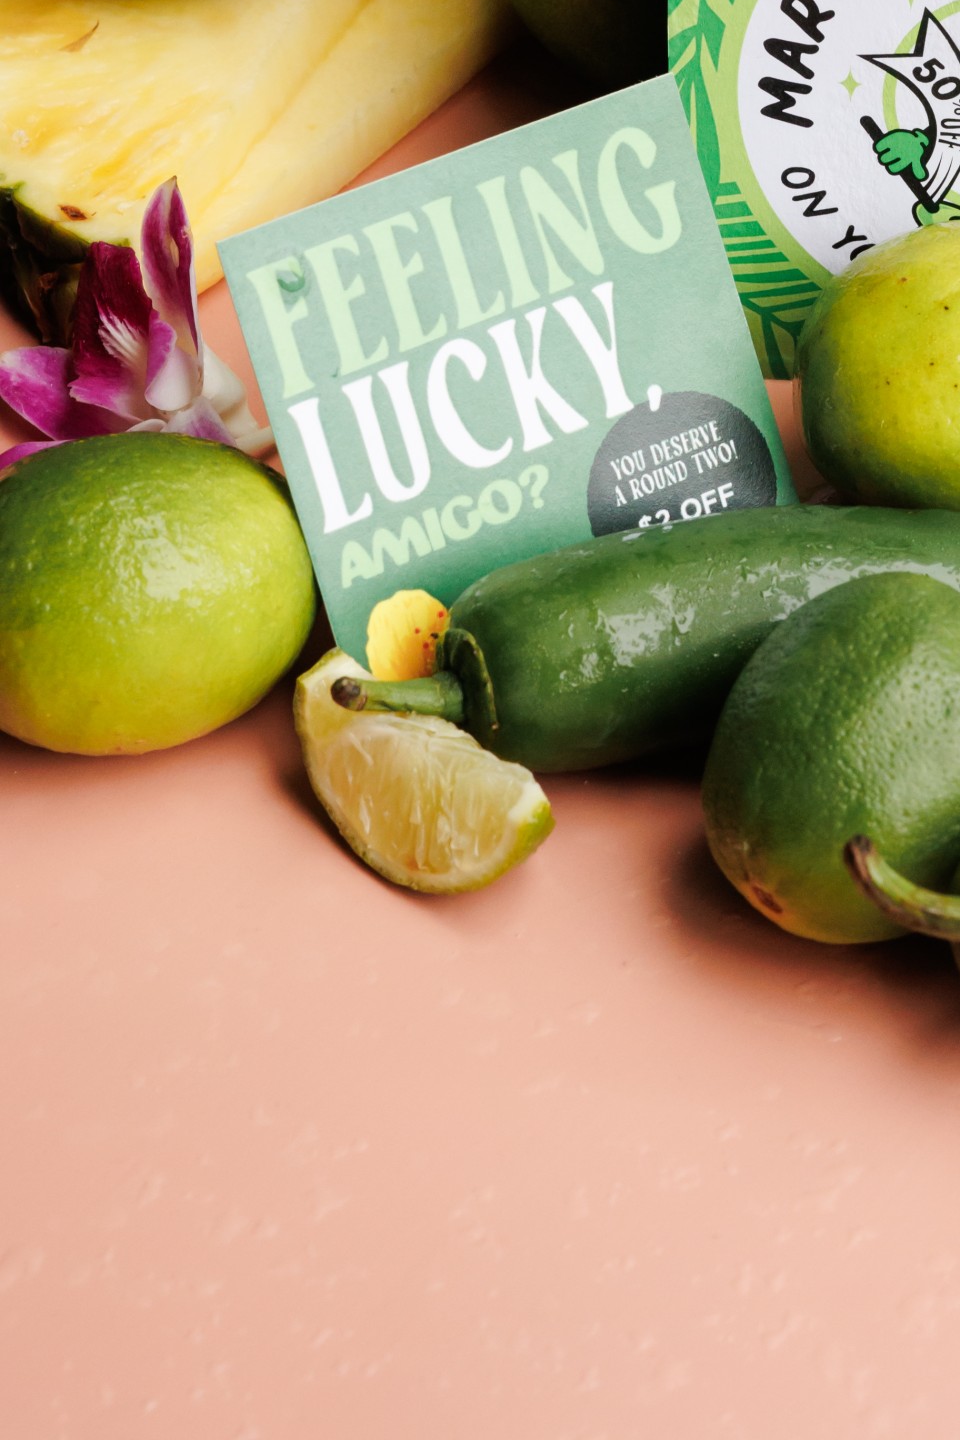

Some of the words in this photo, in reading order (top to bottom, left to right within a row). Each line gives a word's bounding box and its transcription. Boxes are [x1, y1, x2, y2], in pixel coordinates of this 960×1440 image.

[781, 166, 839, 217] ON
[246, 126, 683, 399] FEELING
[288, 281, 663, 534] LUCKY,
[610, 449, 647, 481] YOU
[650, 420, 722, 466] DESERVE
[614, 485, 628, 507] A
[629, 460, 688, 500] ROUND
[691, 439, 739, 474] TWO!
[341, 464, 549, 589] AMIGO?
[680, 482, 735, 520] OFF
